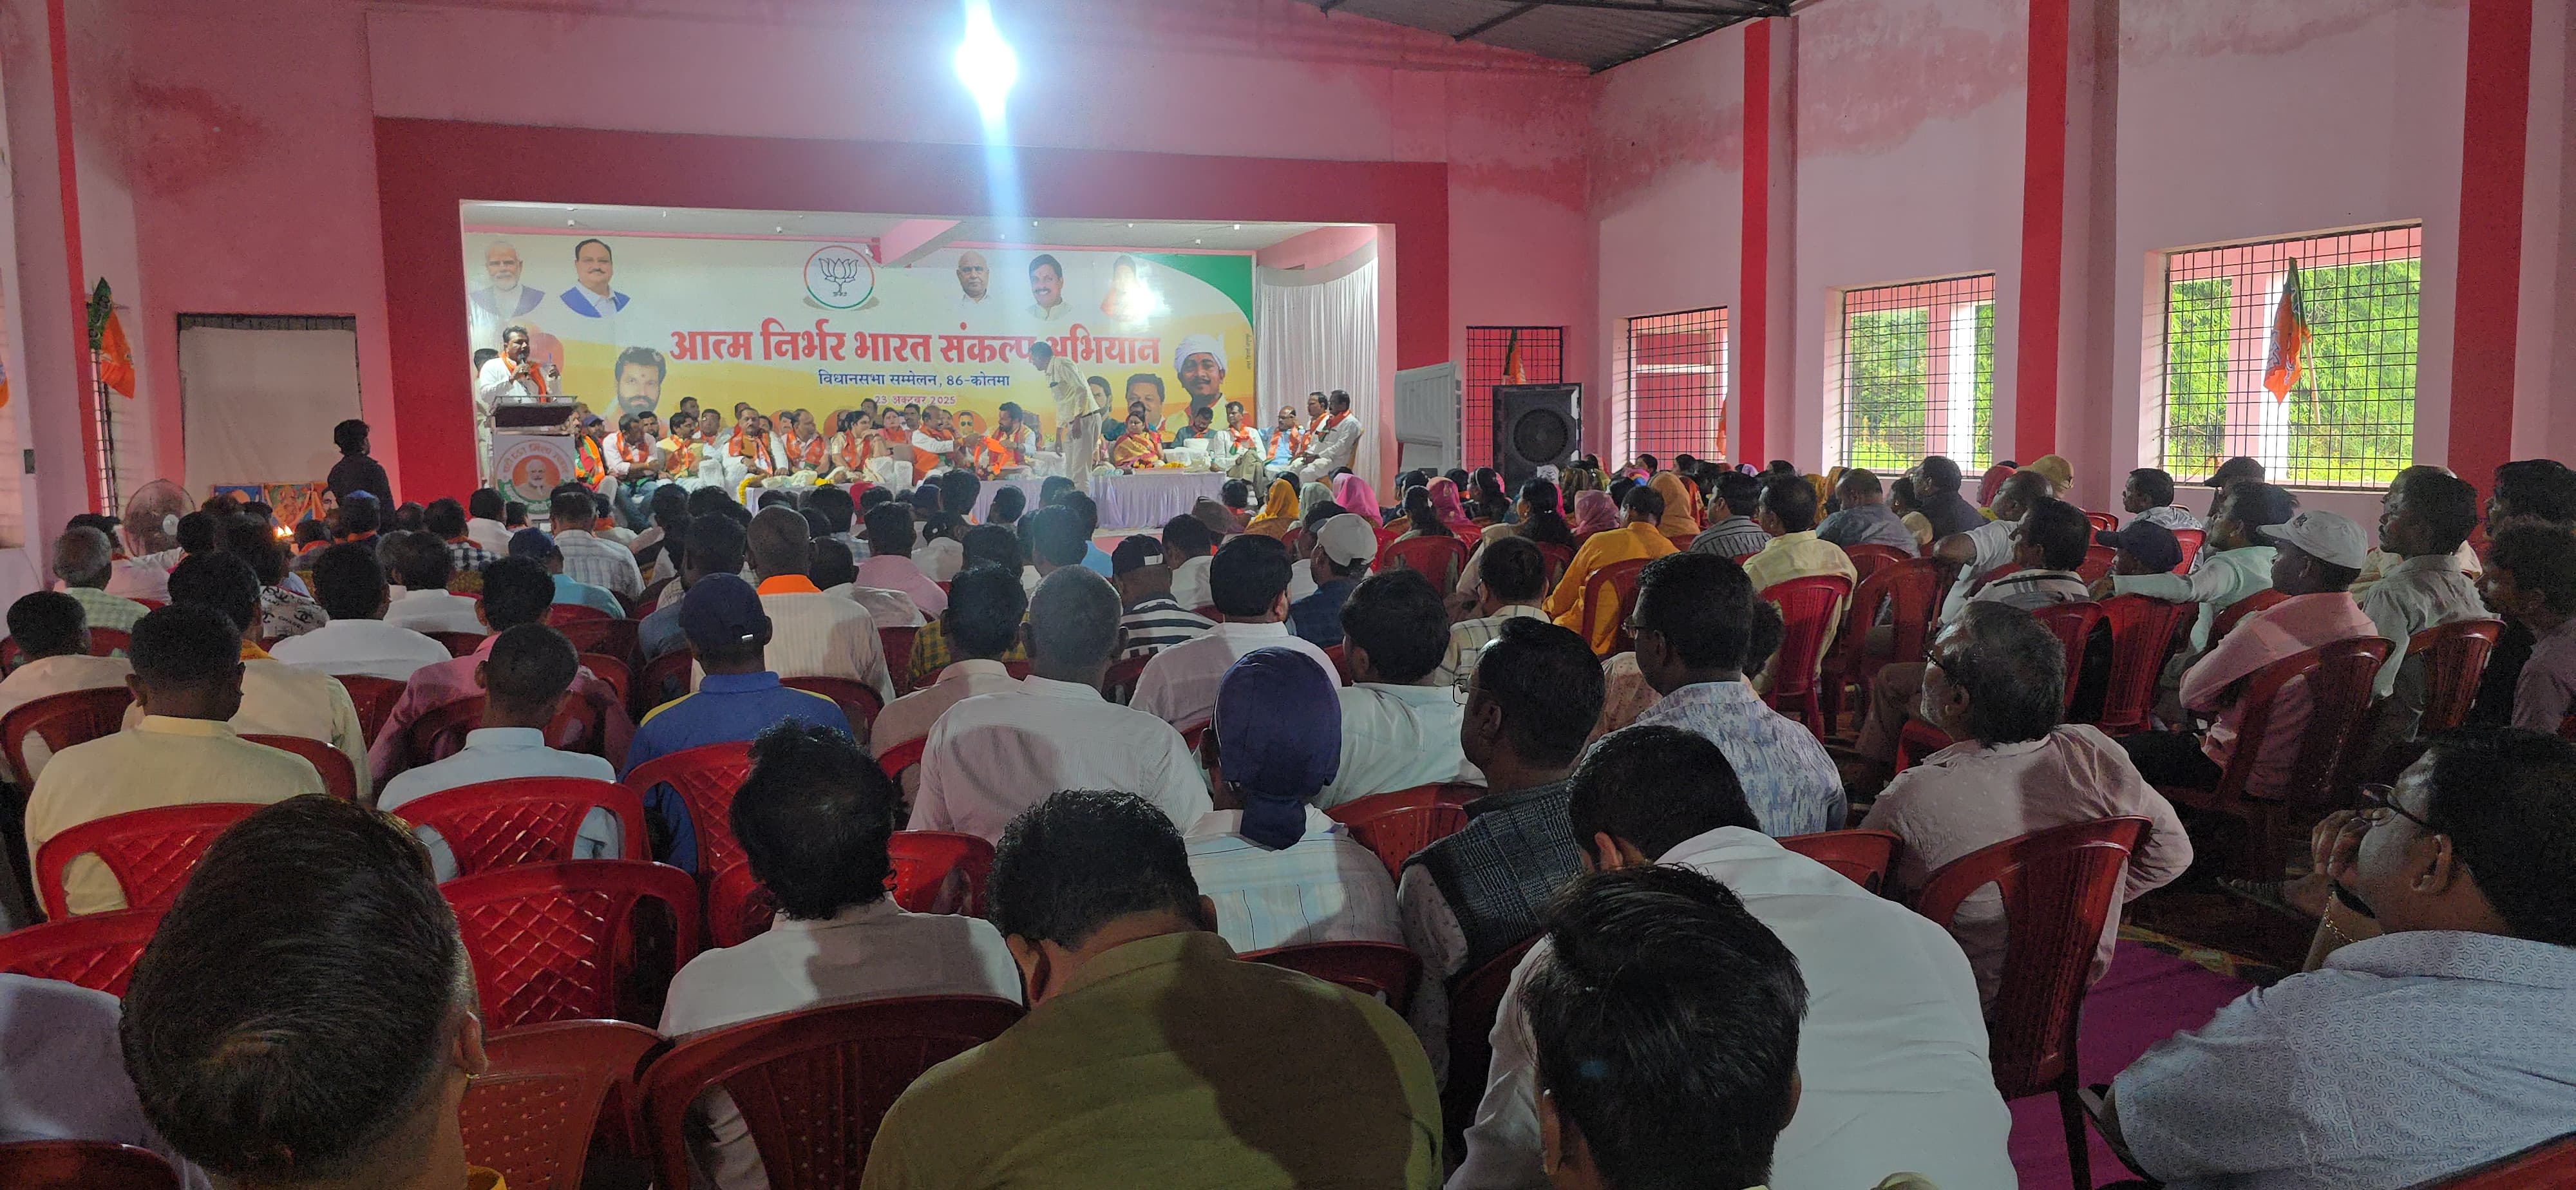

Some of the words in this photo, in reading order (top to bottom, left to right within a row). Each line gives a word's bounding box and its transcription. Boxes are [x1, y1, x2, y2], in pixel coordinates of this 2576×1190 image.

[670, 331, 753, 361] आत्म
[760, 317, 846, 361] निर्भर
[854, 331, 932, 363] भारत
[938, 321, 1037, 364] संकल्प
[1046, 323, 1160, 364] अभियान
[819, 369, 886, 384] विधानसभा
[947, 371, 1010, 386] 86-कोतमा
[930, 395, 956, 404] 2025
